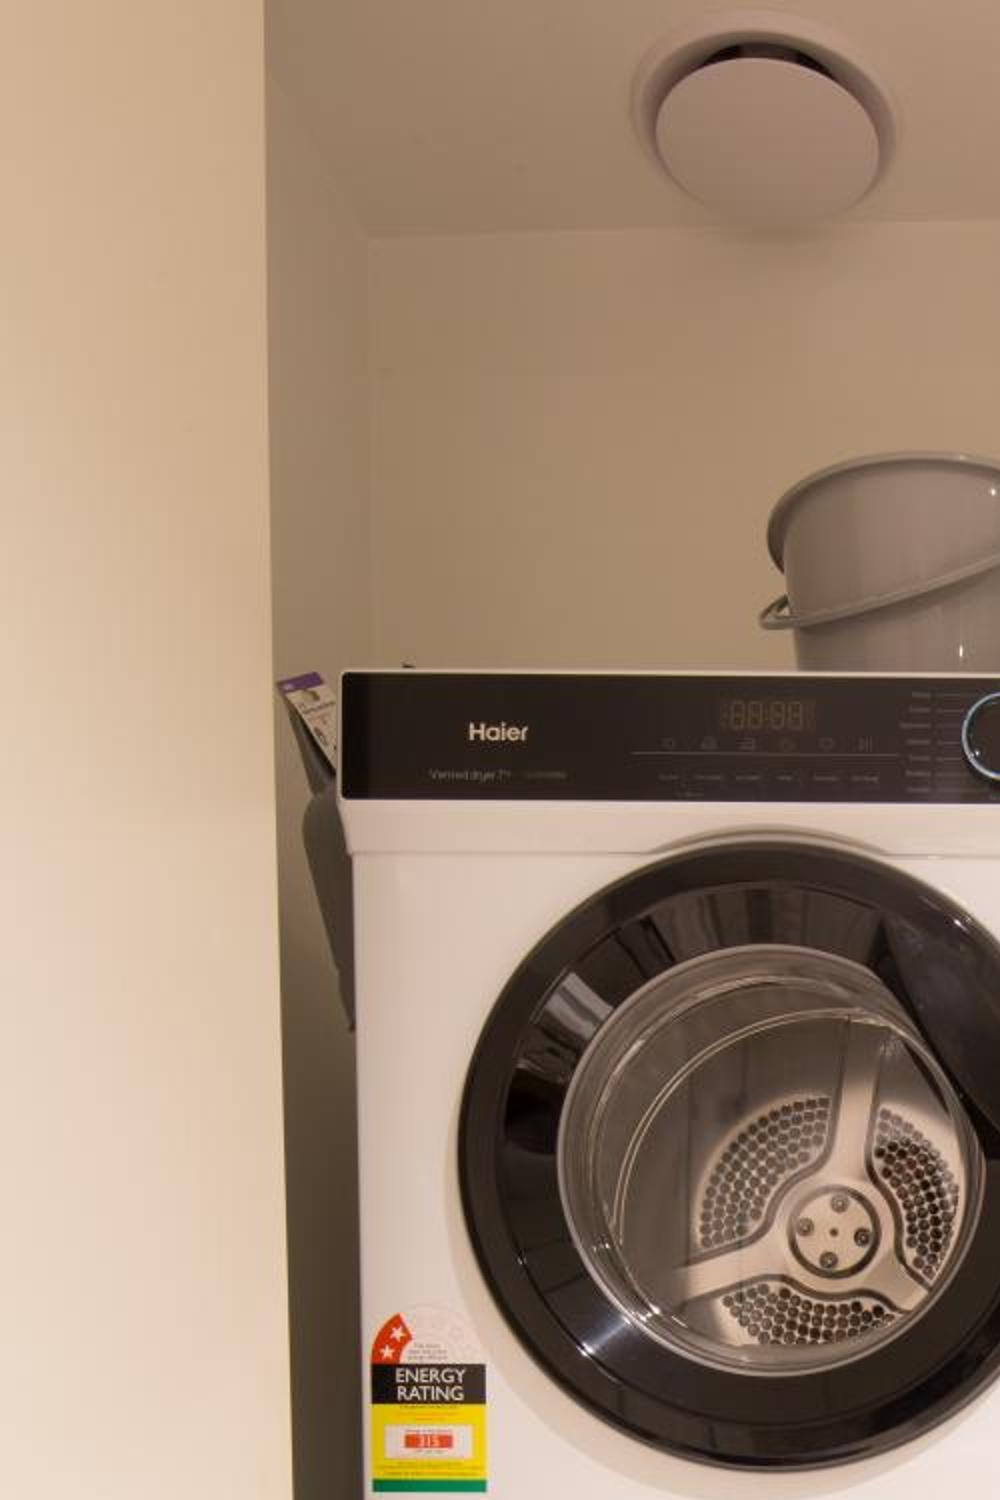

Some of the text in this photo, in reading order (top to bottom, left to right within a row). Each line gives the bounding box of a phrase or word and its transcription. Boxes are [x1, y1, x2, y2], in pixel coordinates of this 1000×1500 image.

[468, 721, 530, 742] Haier
[395, 1367, 466, 1384] ENERGY
[396, 1385, 465, 1401] RATING
